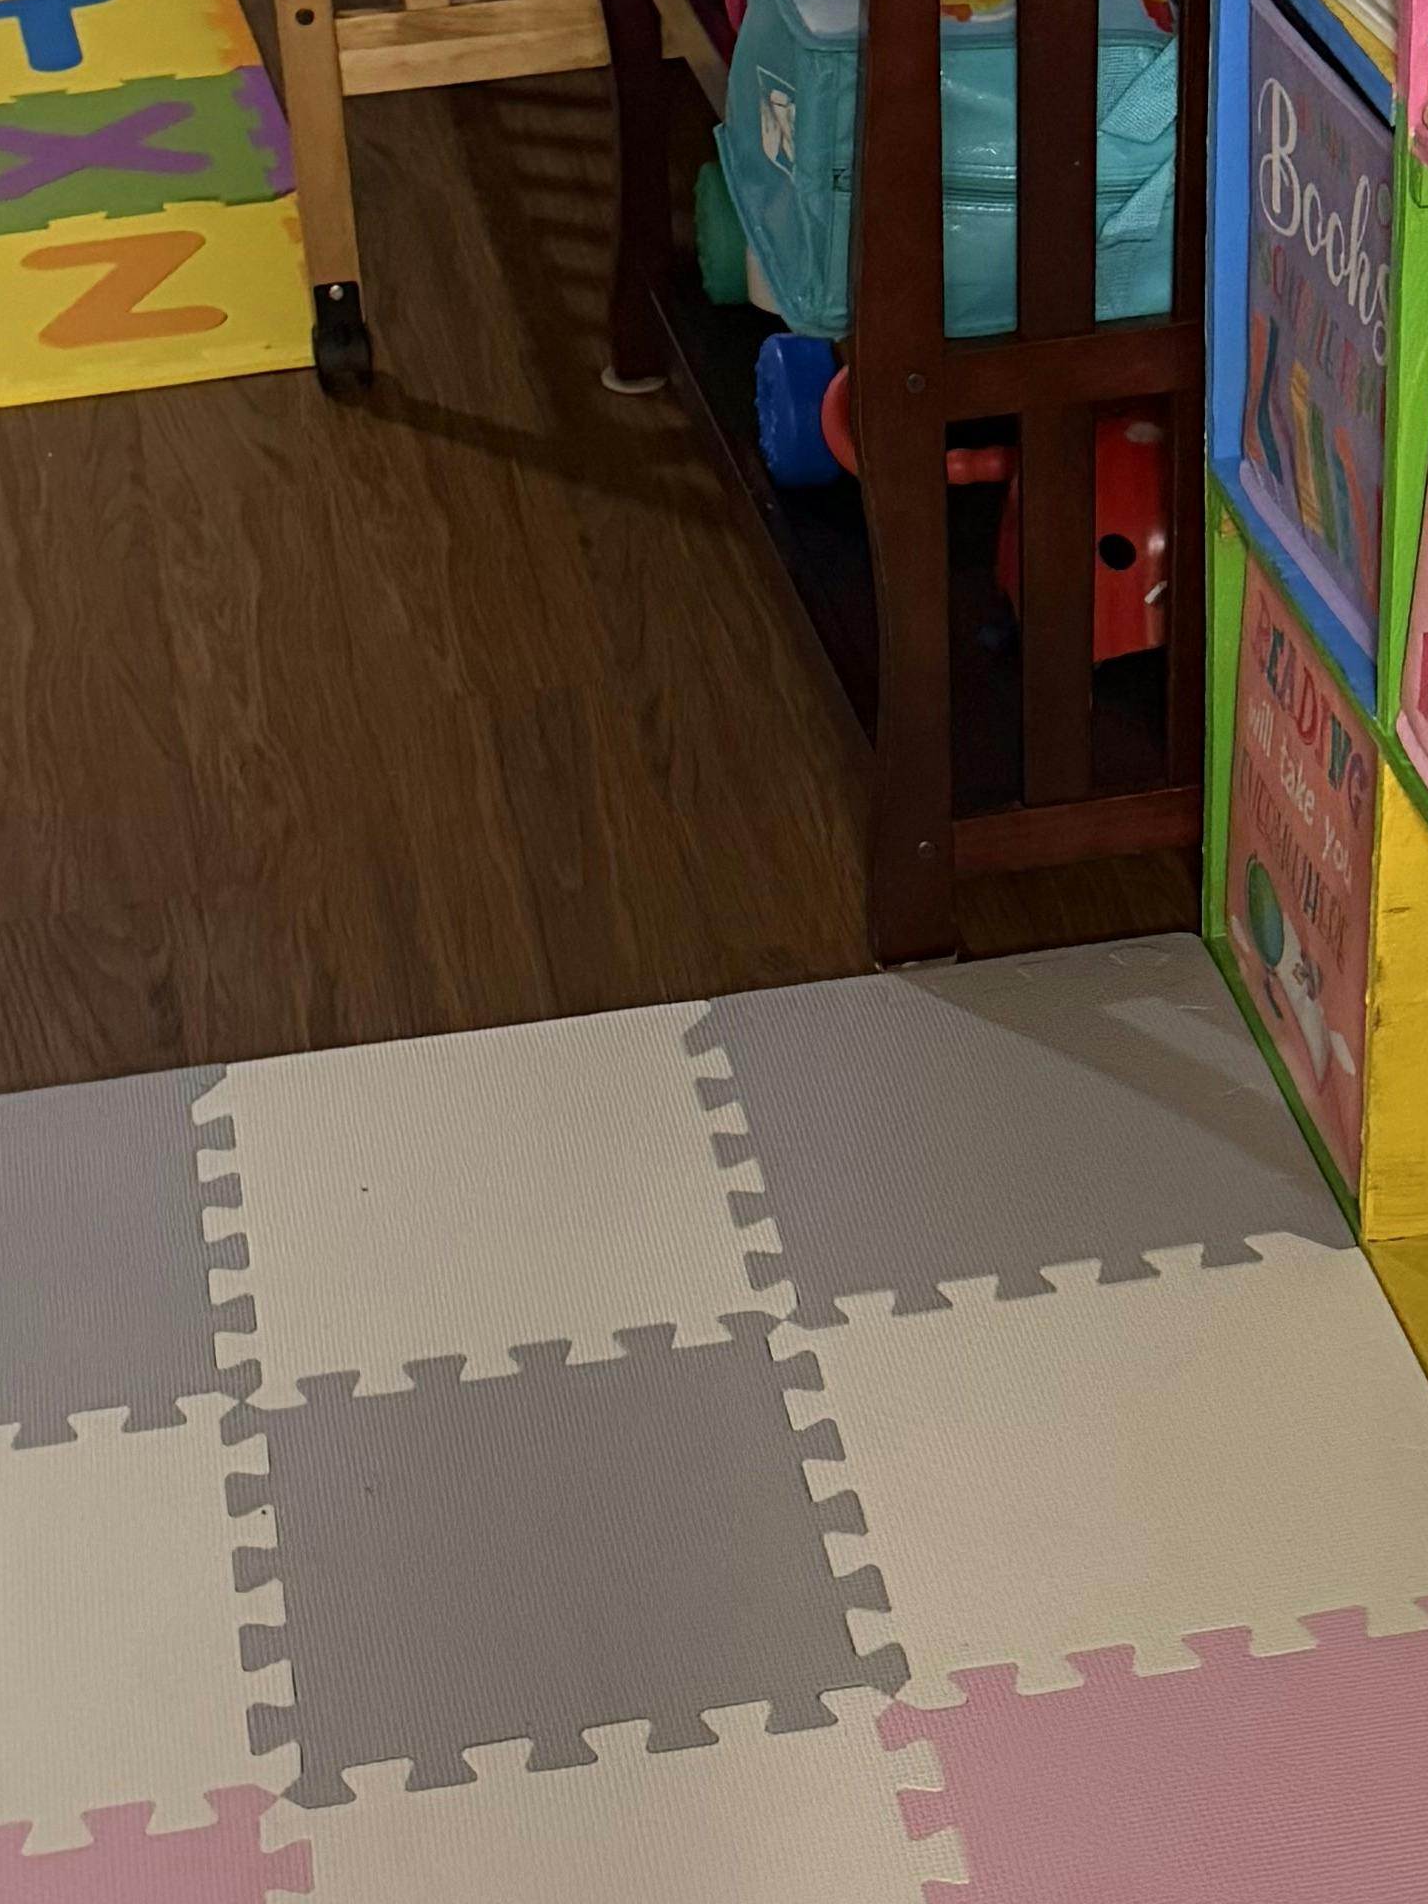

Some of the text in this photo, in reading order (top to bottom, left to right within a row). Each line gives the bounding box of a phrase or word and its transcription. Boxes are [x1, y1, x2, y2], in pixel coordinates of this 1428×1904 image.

[19, 230, 230, 350] Z
[1258, 77, 1390, 367] Books
[1250, 588, 1370, 830] READING
[1279, 735, 1315, 826] take
[1320, 815, 1352, 894] you
